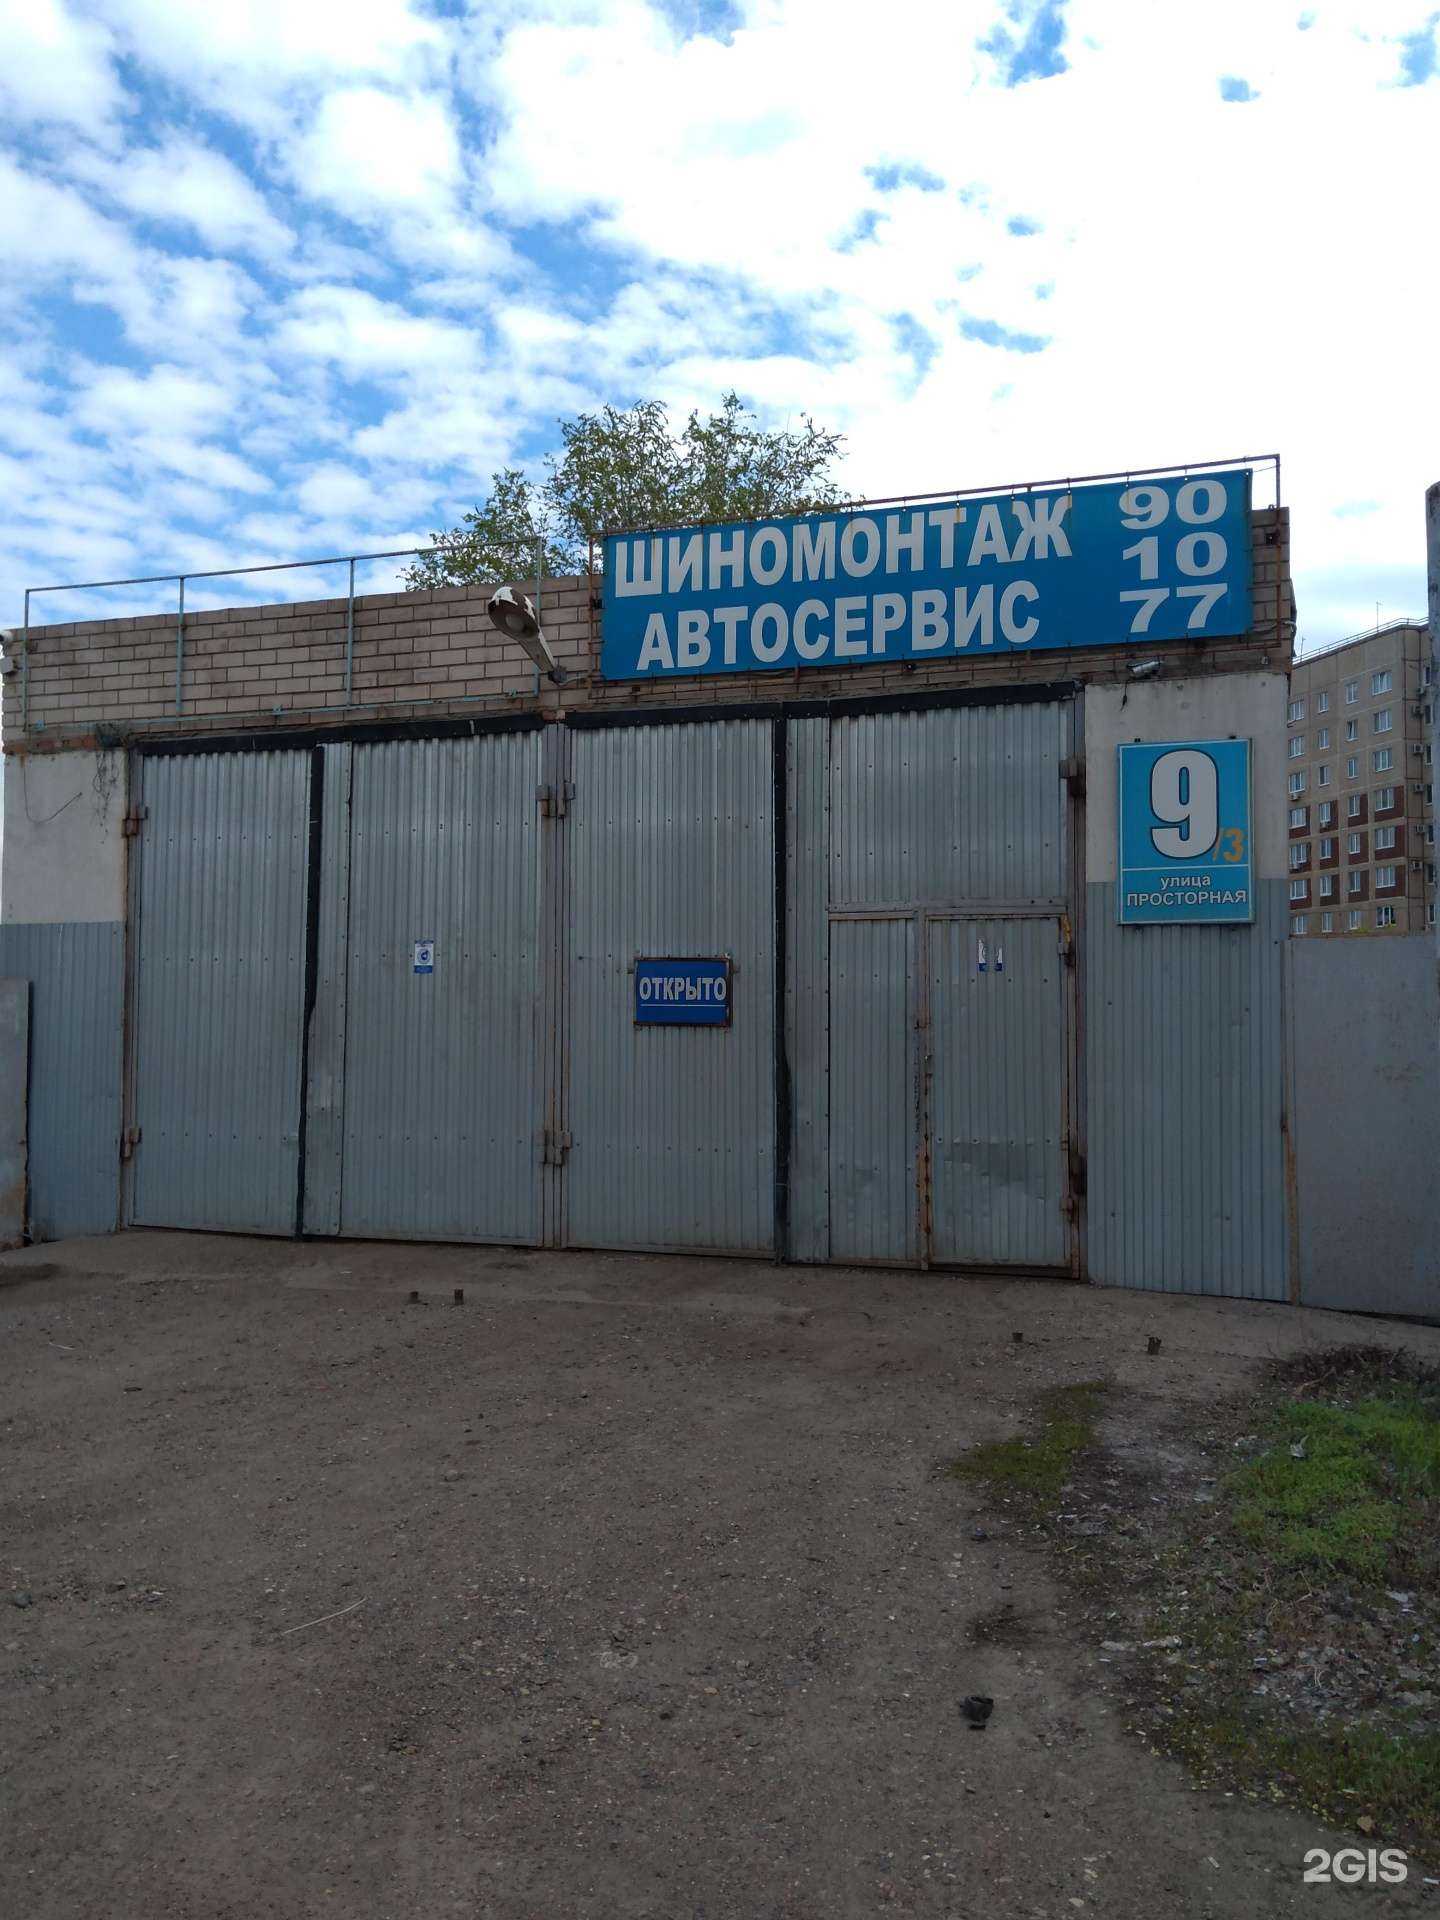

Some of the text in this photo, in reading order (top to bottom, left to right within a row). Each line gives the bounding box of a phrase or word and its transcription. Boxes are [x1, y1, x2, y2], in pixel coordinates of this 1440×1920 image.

[1118, 480, 1228, 530] 90
[614, 495, 1073, 598] ШИНОМОНТАЖ
[1122, 531, 1229, 581] 10
[636, 580, 1041, 671] АВТОСЕРВИС
[1118, 583, 1229, 634] 77
[1126, 890, 1247, 907] ПРОСТОРНАЯ
[1160, 875, 1211, 891] улица
[639, 976, 727, 1001] ОТКРЫТО
